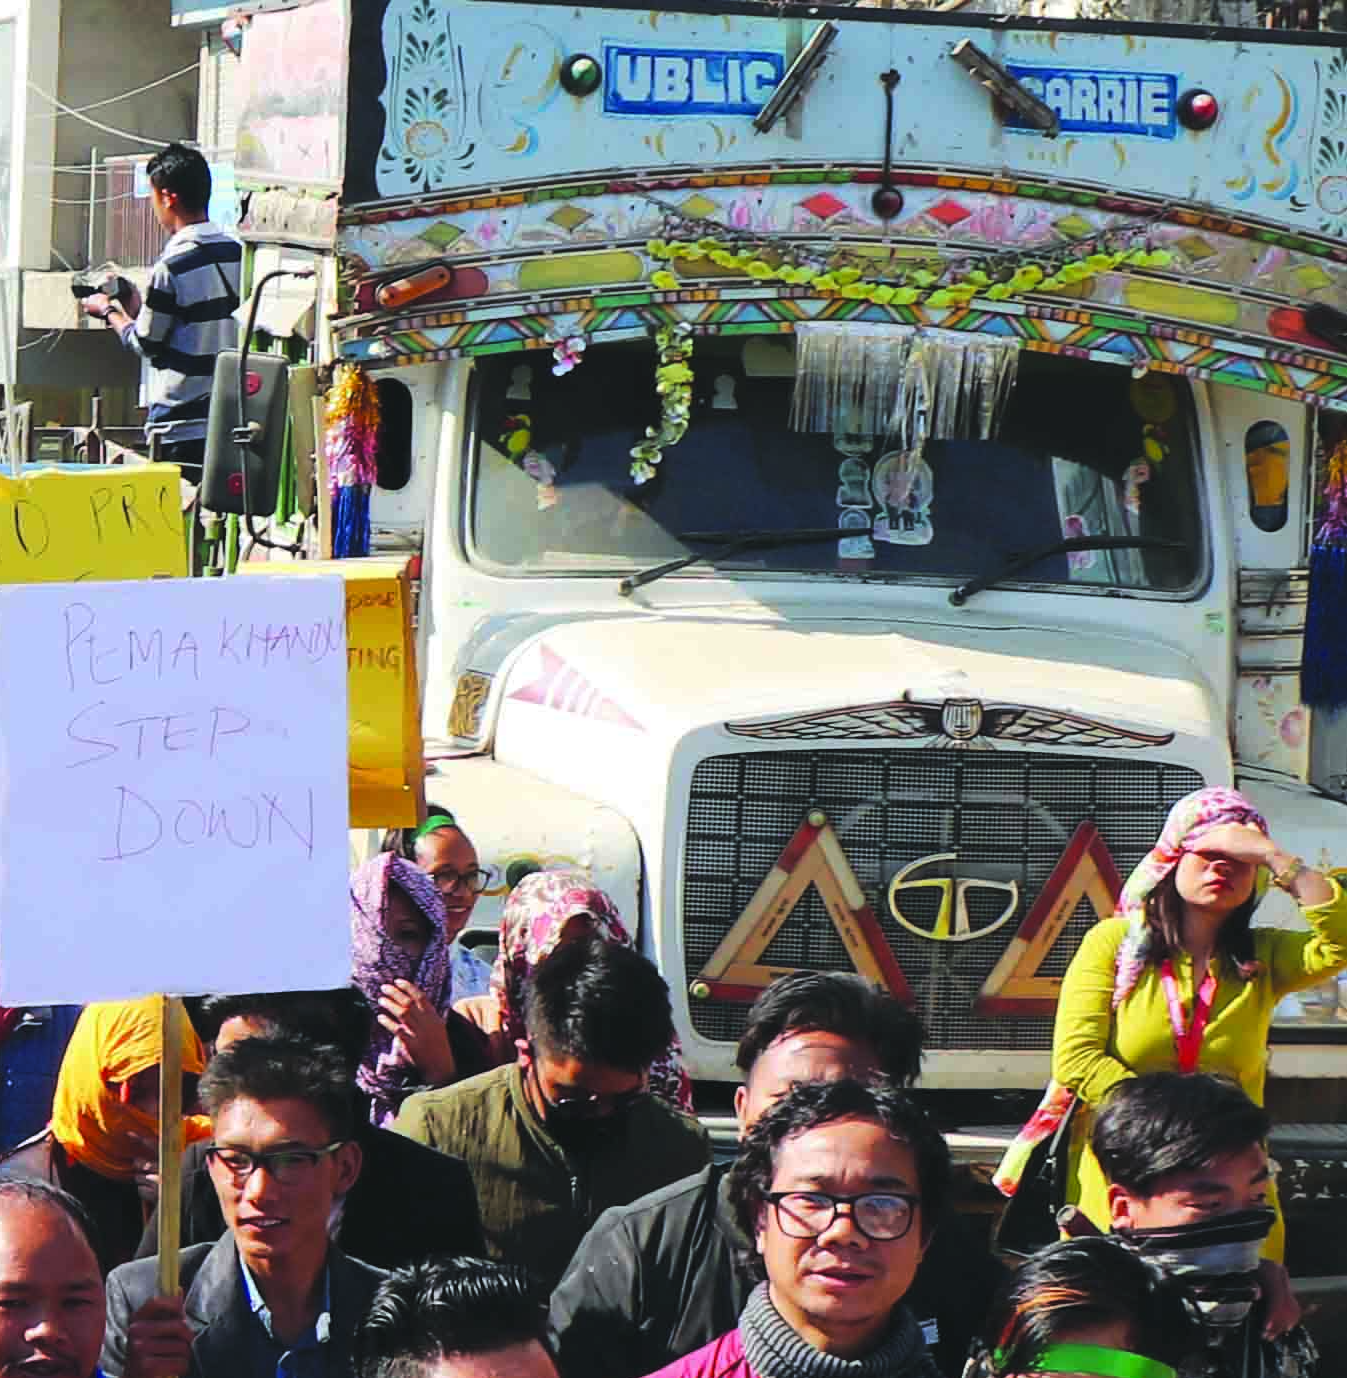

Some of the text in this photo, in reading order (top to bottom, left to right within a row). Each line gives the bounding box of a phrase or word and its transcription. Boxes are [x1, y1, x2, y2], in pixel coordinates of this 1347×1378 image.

[61, 600, 202, 690] PEMA
[346, 645, 402, 681] TING
[64, 699, 253, 769] STEP
[97, 784, 315, 863] DOWN
